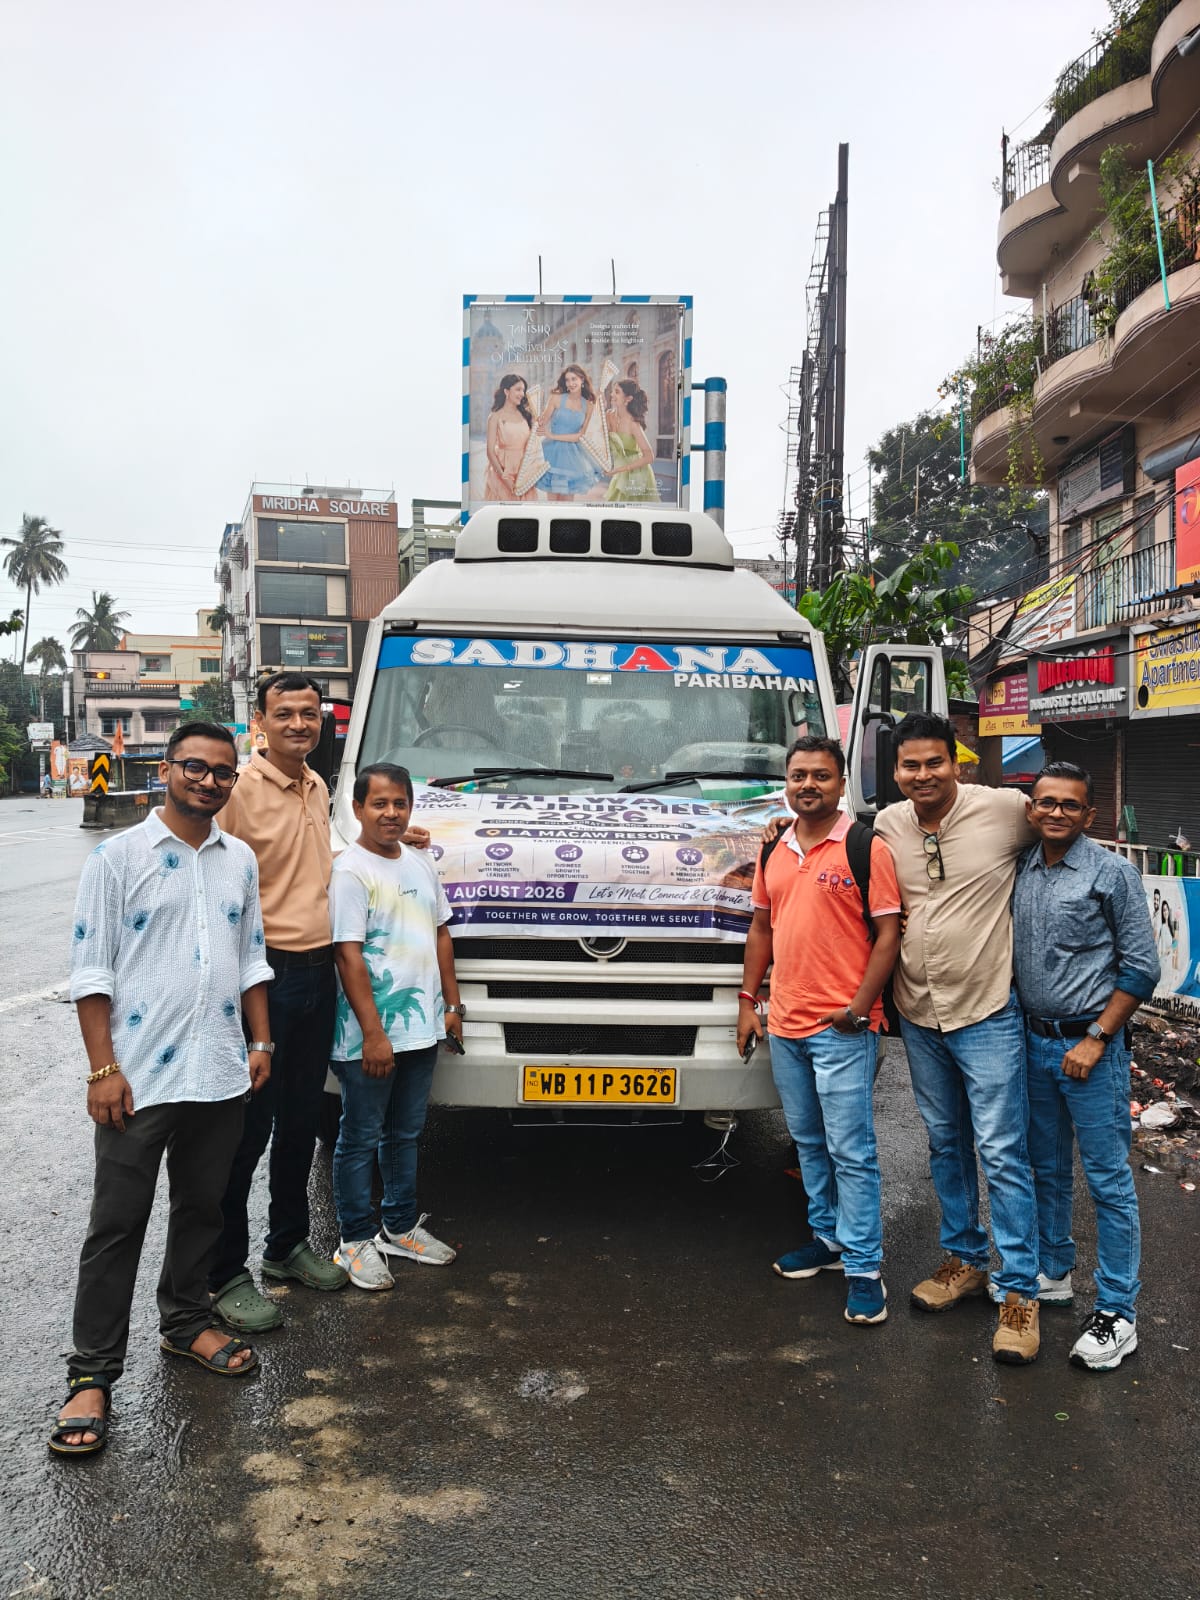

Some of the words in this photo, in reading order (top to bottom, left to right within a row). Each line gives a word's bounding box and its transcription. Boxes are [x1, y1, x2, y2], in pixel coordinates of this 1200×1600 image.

[507, 341, 546, 352] Festival
[261, 496, 320, 513] MRIDHA
[329, 500, 390, 516] SQUARE
[410, 638, 782, 675] SADHANA
[674, 672, 815, 694] PARIBAHAN
[507, 829, 532, 837] LA
[539, 830, 609, 839] MACAW
[614, 832, 681, 841] RESORT
[453, 885, 521, 899] AUGUST
[524, 886, 566, 899] 2026
[589, 886, 614, 899] Let's
[648, 887, 687, 901] Connect
[690, 888, 700, 900] &
[702, 889, 745, 904] Celebrate
[485, 911, 538, 920] TOGETHER
[541, 911, 556, 920] WE
[595, 913, 647, 922] TOGETHER
[650, 914, 665, 922] WE
[668, 914, 700, 923] SERVE
[1174, 997, 1200, 1019] Hardw
[540, 1072, 566, 1095] WB
[574, 1073, 595, 1096] 11
[602, 1074, 614, 1096] P
[619, 1074, 672, 1097] 3626
